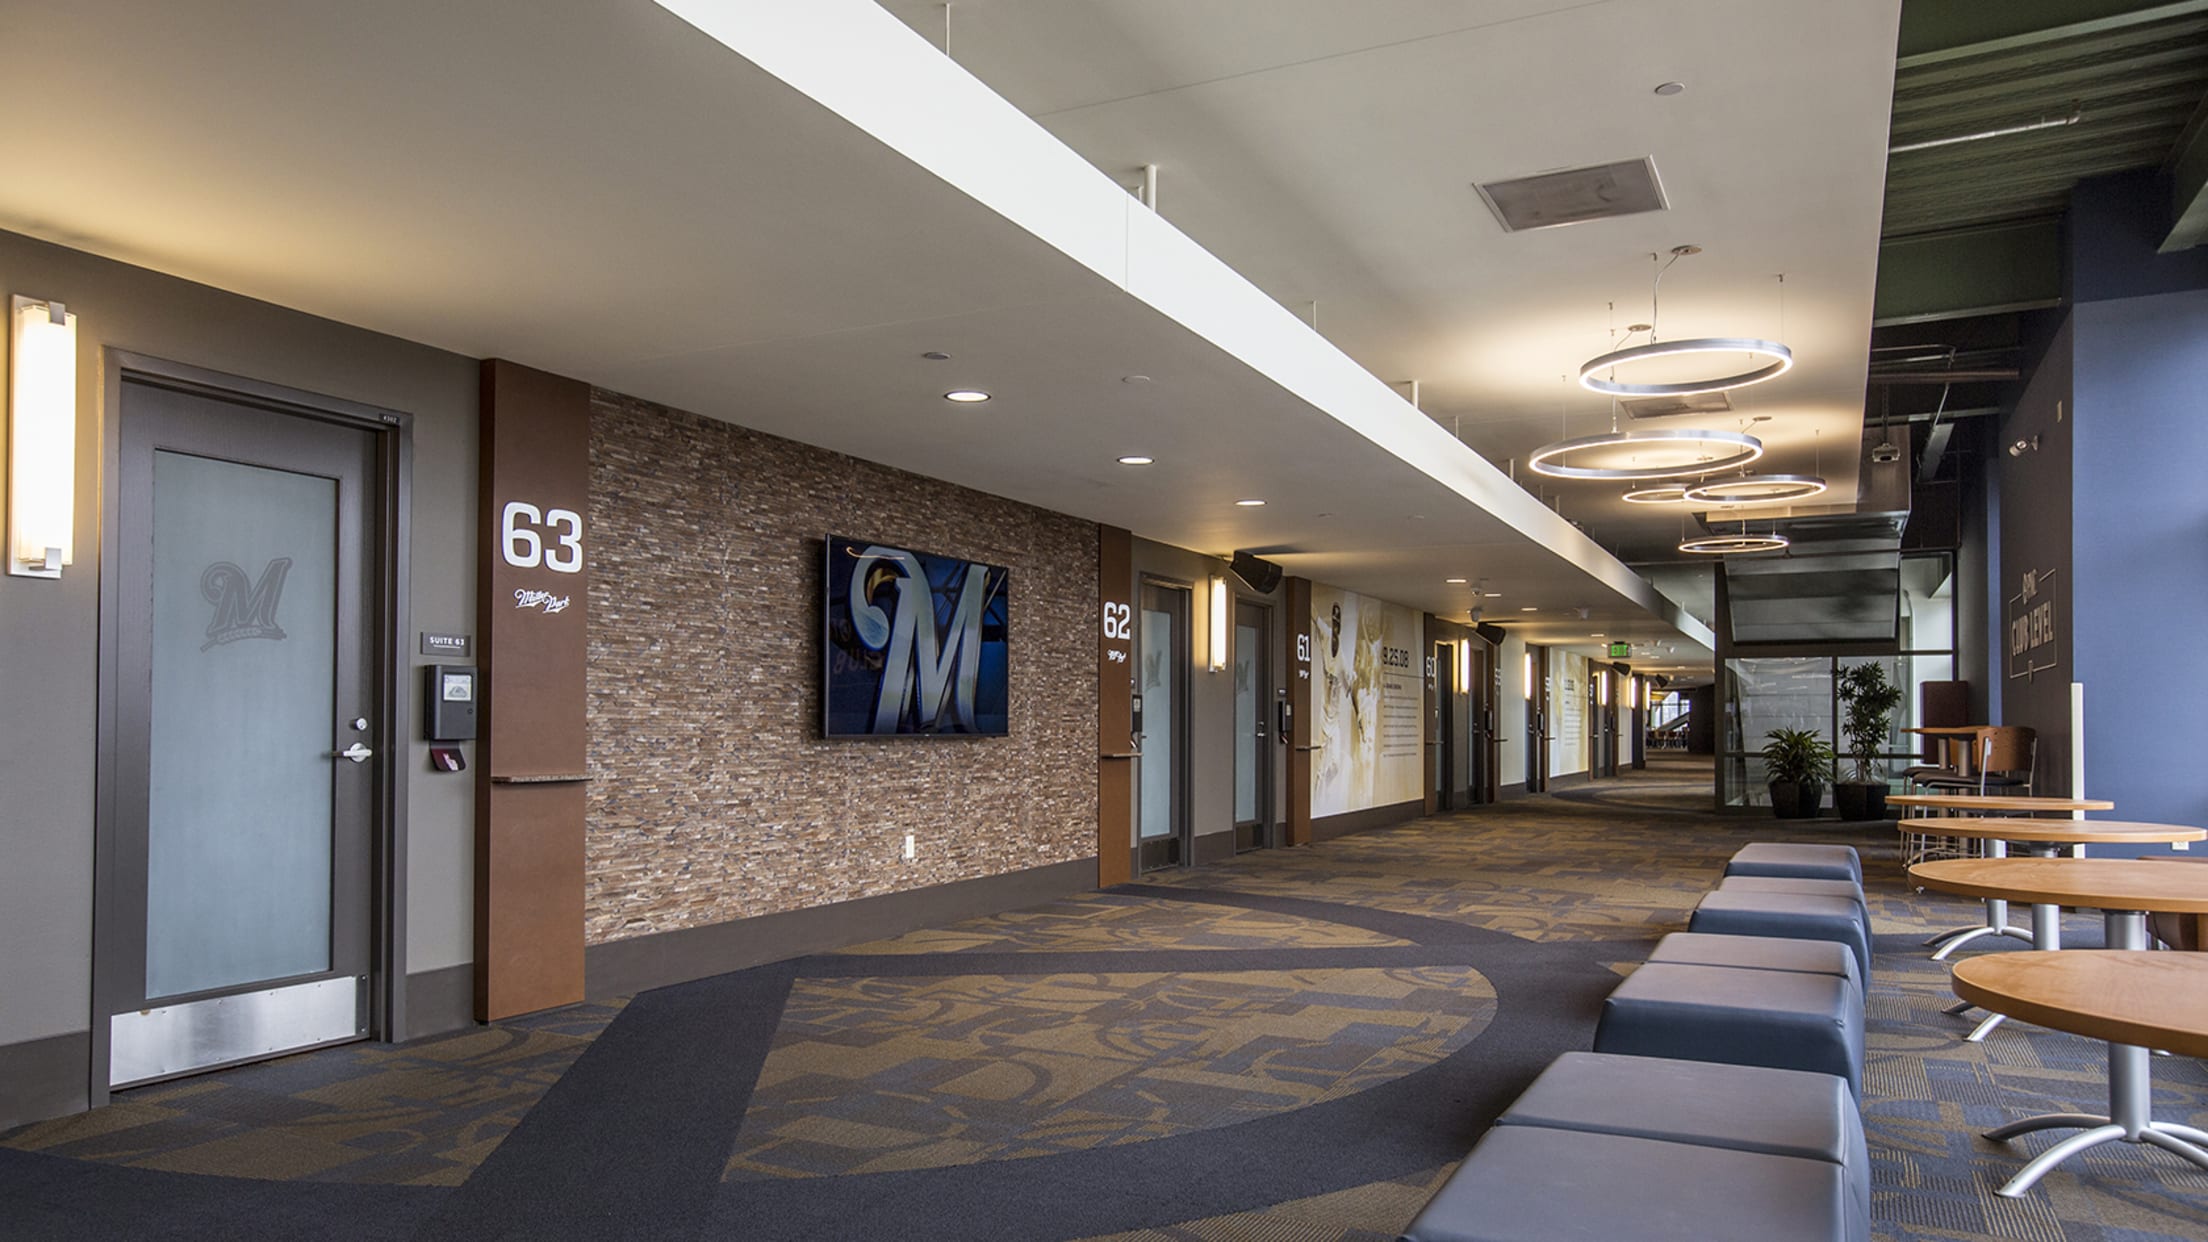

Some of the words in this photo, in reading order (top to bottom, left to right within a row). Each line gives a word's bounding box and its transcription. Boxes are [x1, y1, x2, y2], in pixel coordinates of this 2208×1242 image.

[502, 501, 582, 573] 63
[201, 557, 292, 641] M
[514, 588, 550, 608] Miller
[542, 595, 571, 614] Park
[1104, 601, 1130, 640] 62
[2029, 600, 2053, 649] LEVEL
[429, 635, 453, 646] SUITE
[1297, 633, 1310, 662] 61
